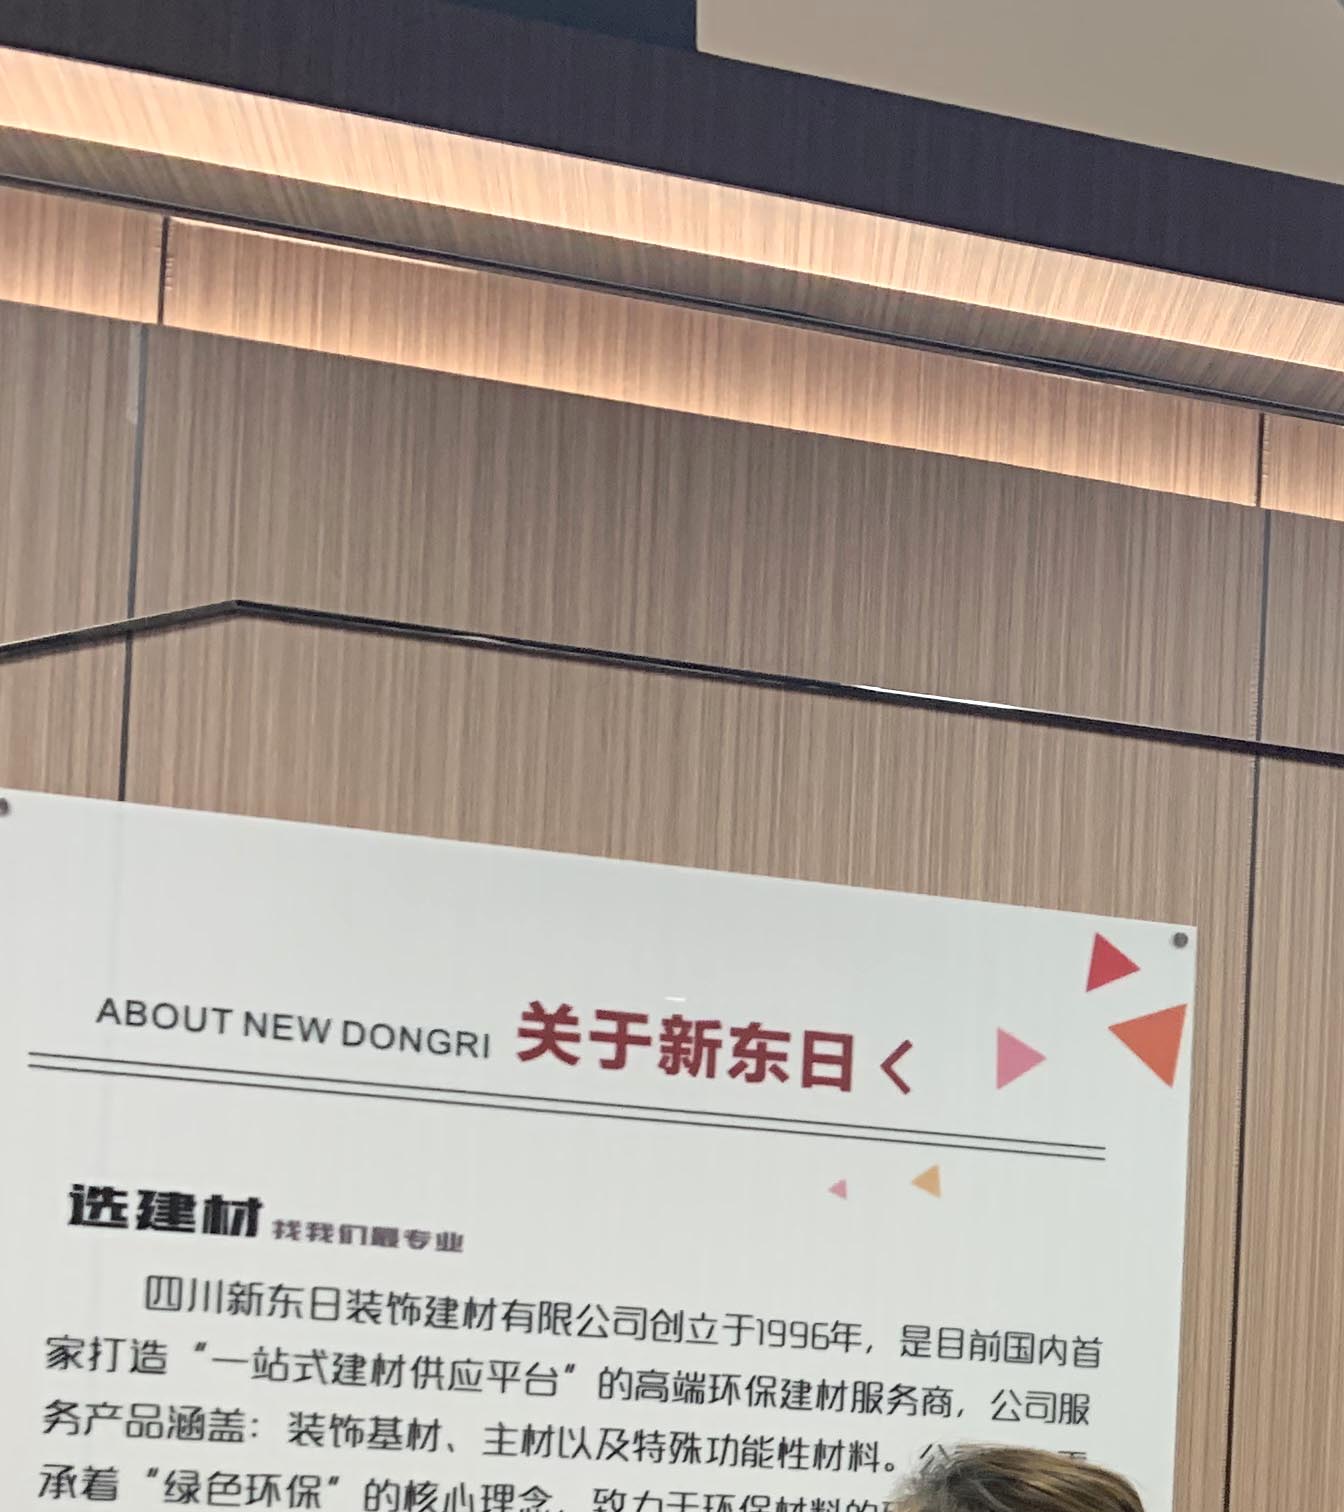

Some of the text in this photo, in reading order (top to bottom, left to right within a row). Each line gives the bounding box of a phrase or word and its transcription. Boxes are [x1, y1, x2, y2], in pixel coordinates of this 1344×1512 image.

[95, 996, 492, 1060] ABOUT NEW DONGRI
[516, 999, 855, 1095] 关于新东日
[67, 1182, 466, 1254] 选建材 找我们最专业
